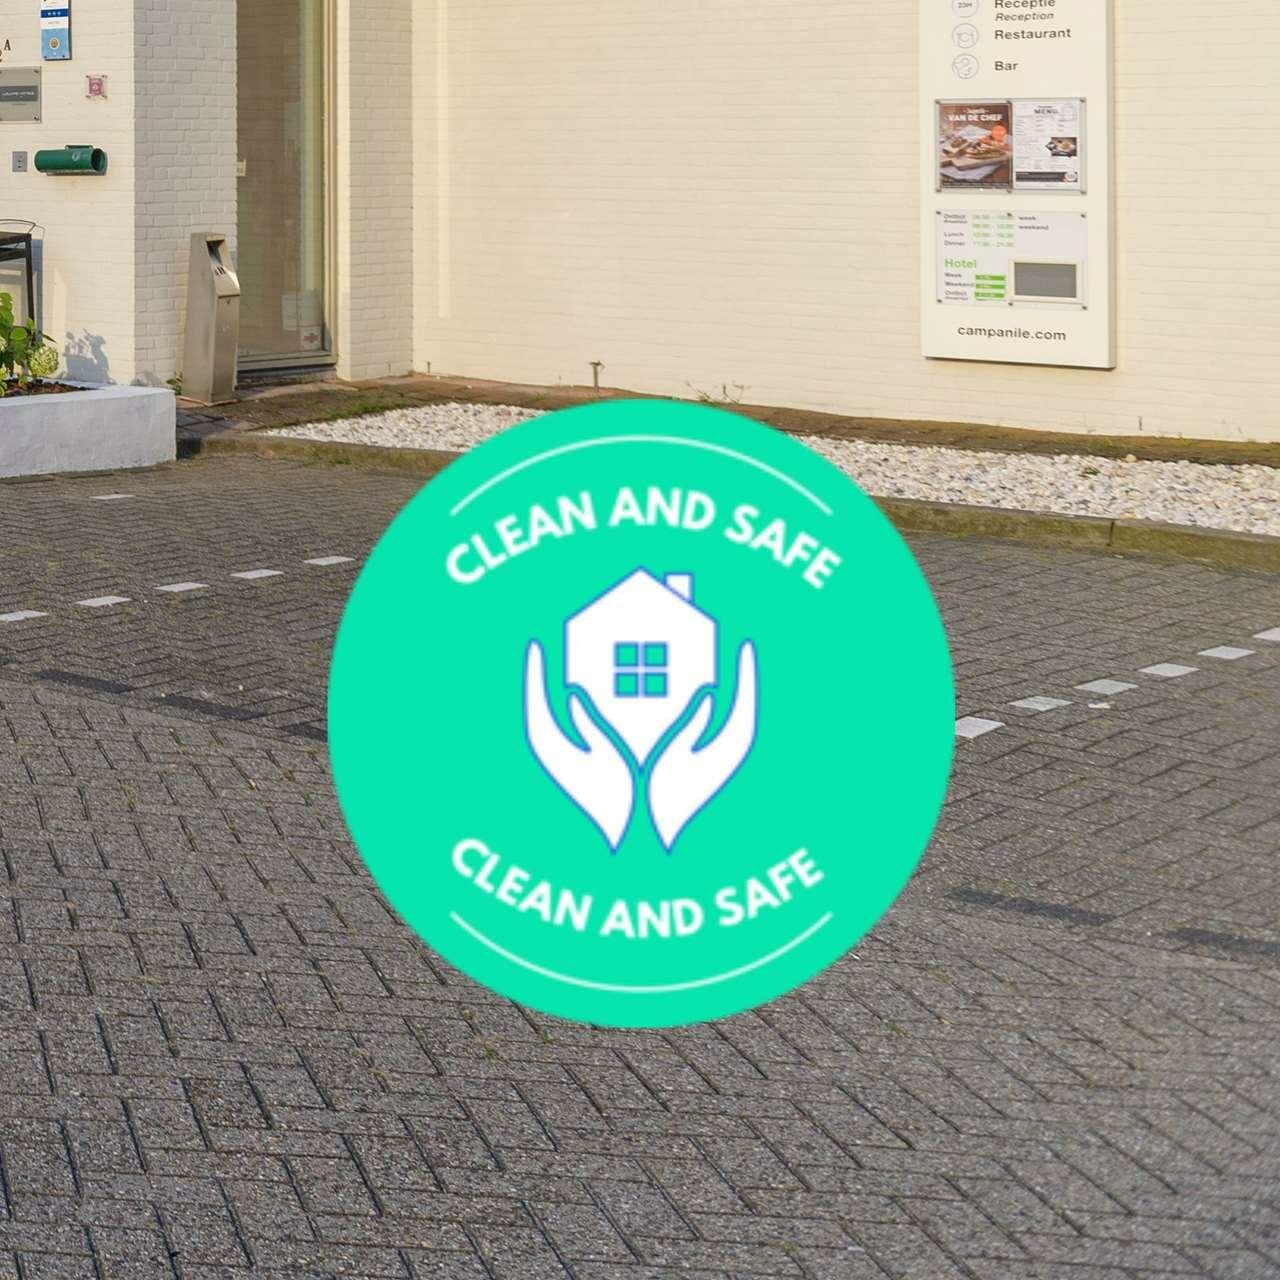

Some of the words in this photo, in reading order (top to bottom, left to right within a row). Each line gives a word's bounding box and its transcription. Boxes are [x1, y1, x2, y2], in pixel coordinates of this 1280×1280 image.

[995, 12, 1054, 22] Reception
[994, 29, 1072, 40] Restaurant
[994, 61, 1018, 71] Bar
[944, 259, 976, 268] Hotel
[958, 325, 1066, 341] campanile.com
